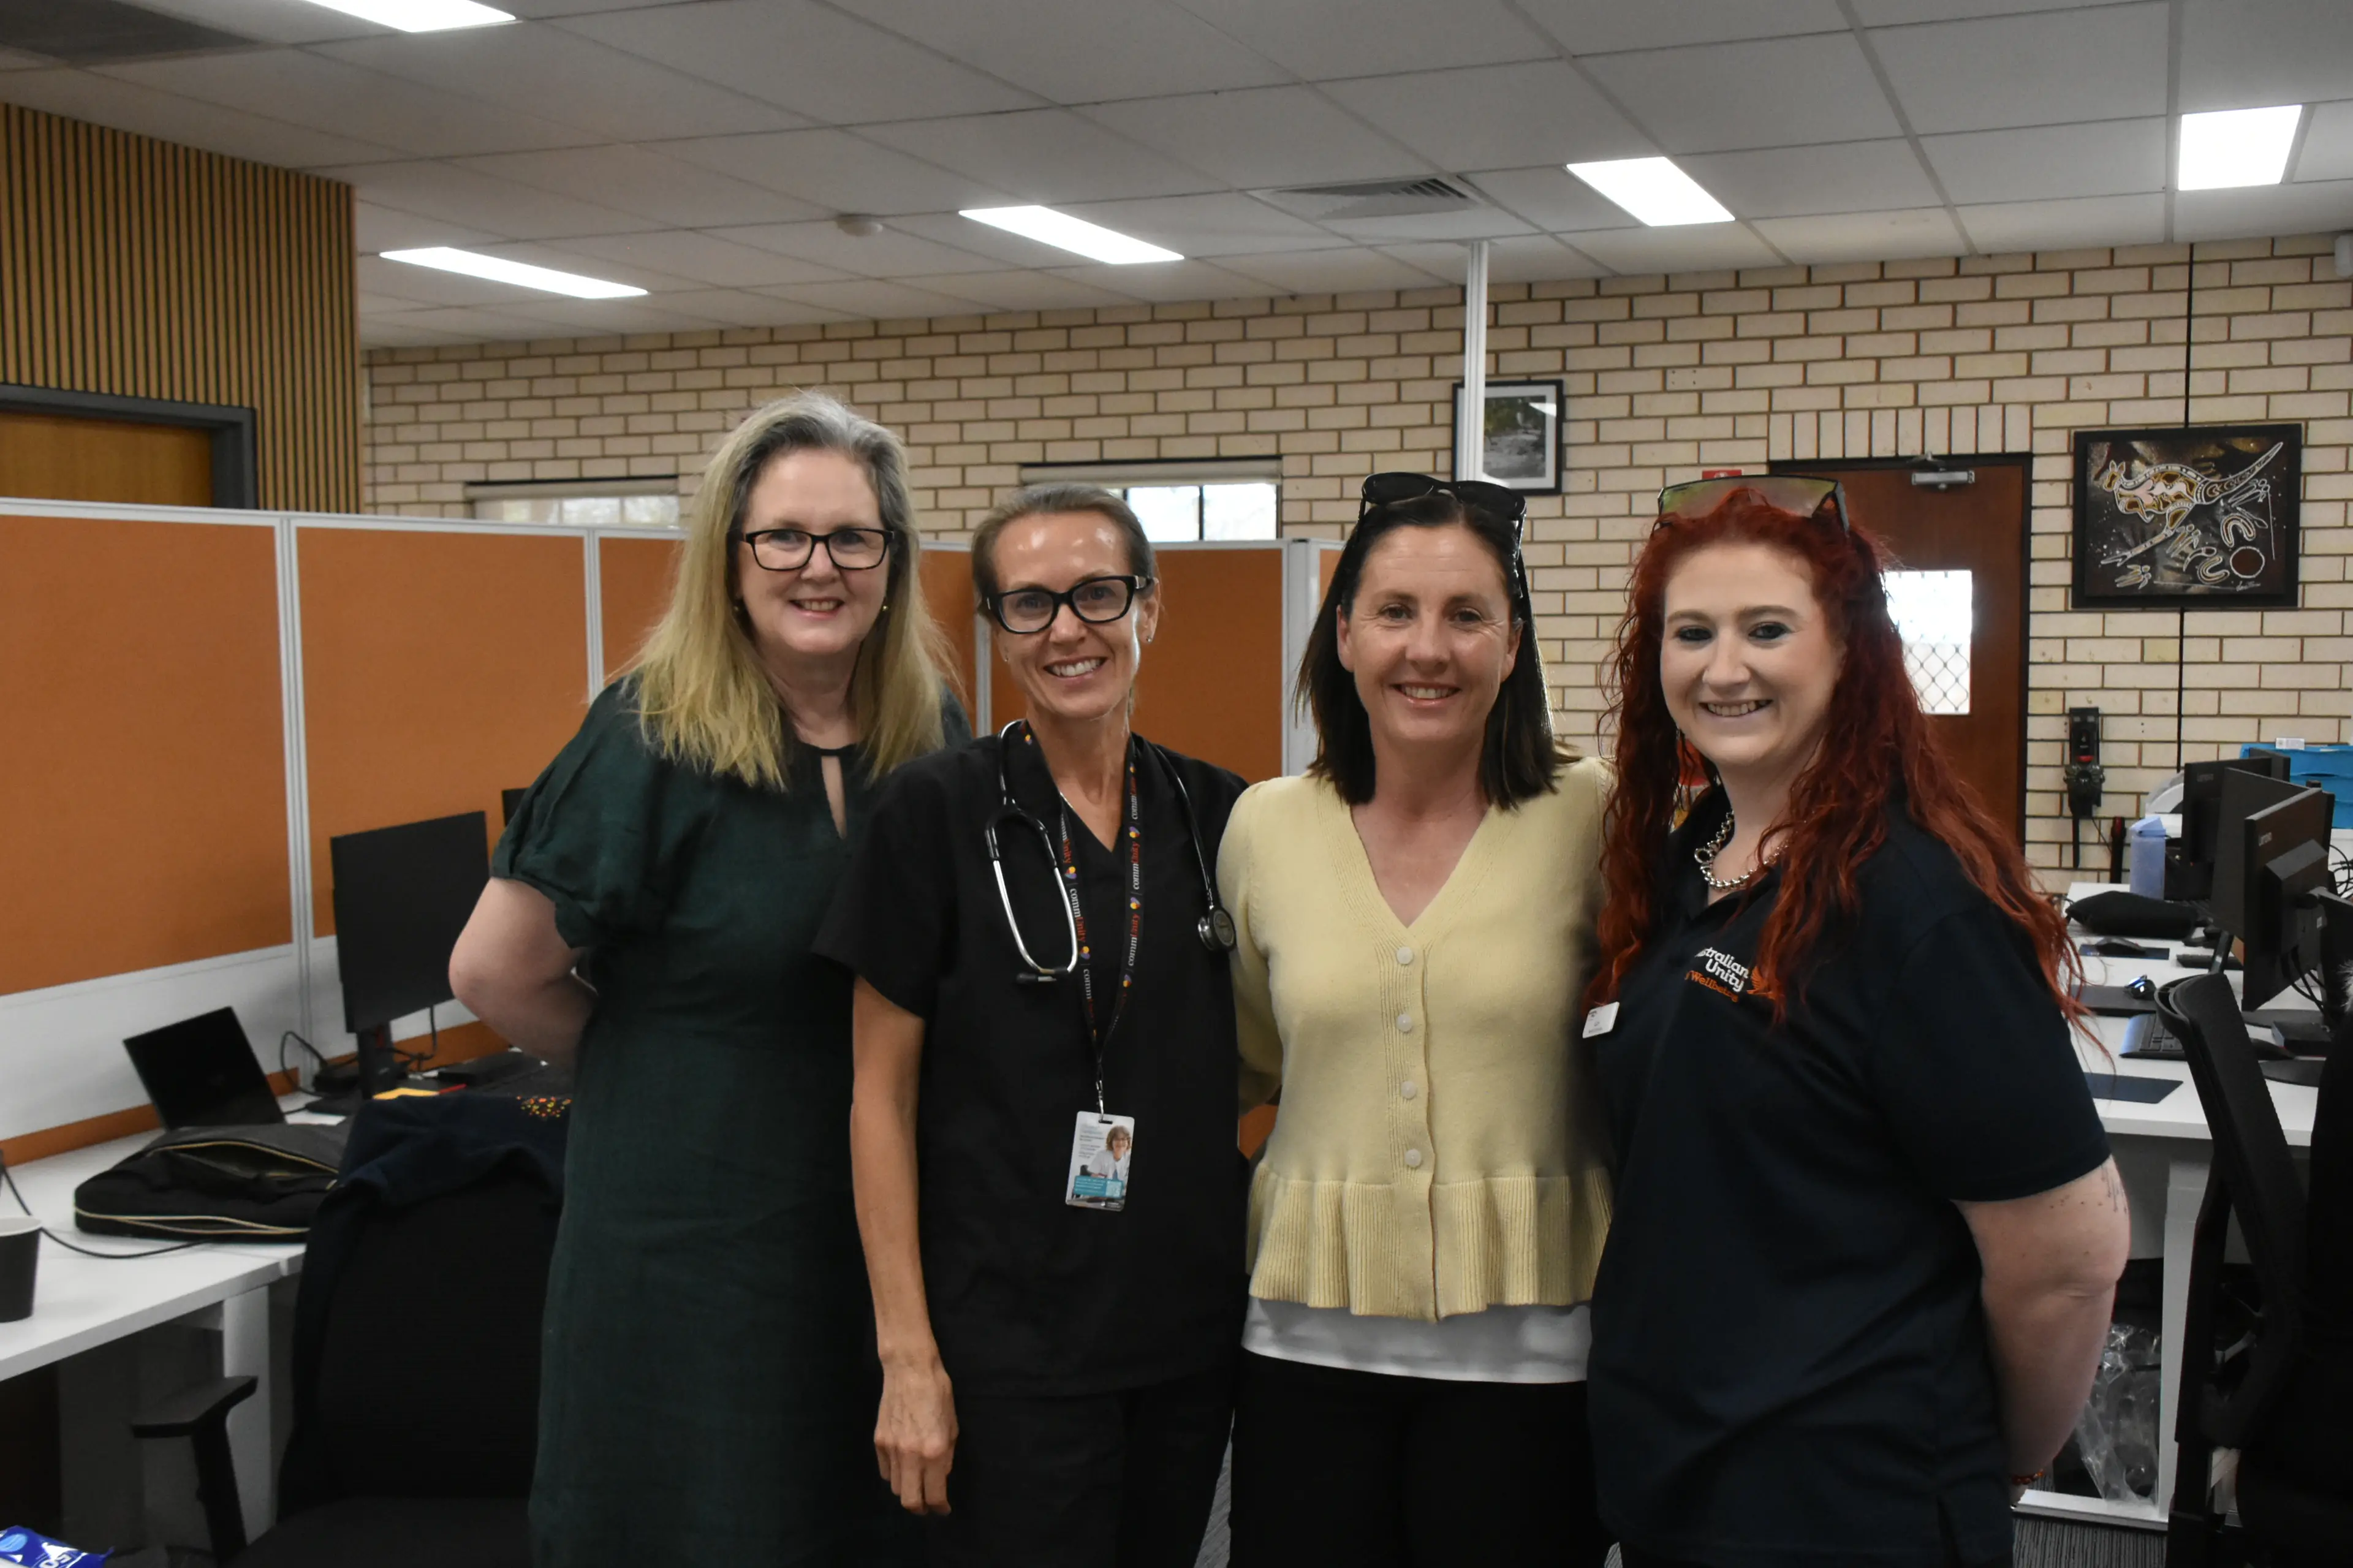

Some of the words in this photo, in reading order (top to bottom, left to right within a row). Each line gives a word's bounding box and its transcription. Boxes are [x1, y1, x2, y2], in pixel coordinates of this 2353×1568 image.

[1131, 841, 1140, 890] commUnity
[1069, 888, 1087, 942] commUnity
[1128, 913, 1141, 966] commUnity
[1705, 958, 1745, 993] Unity
